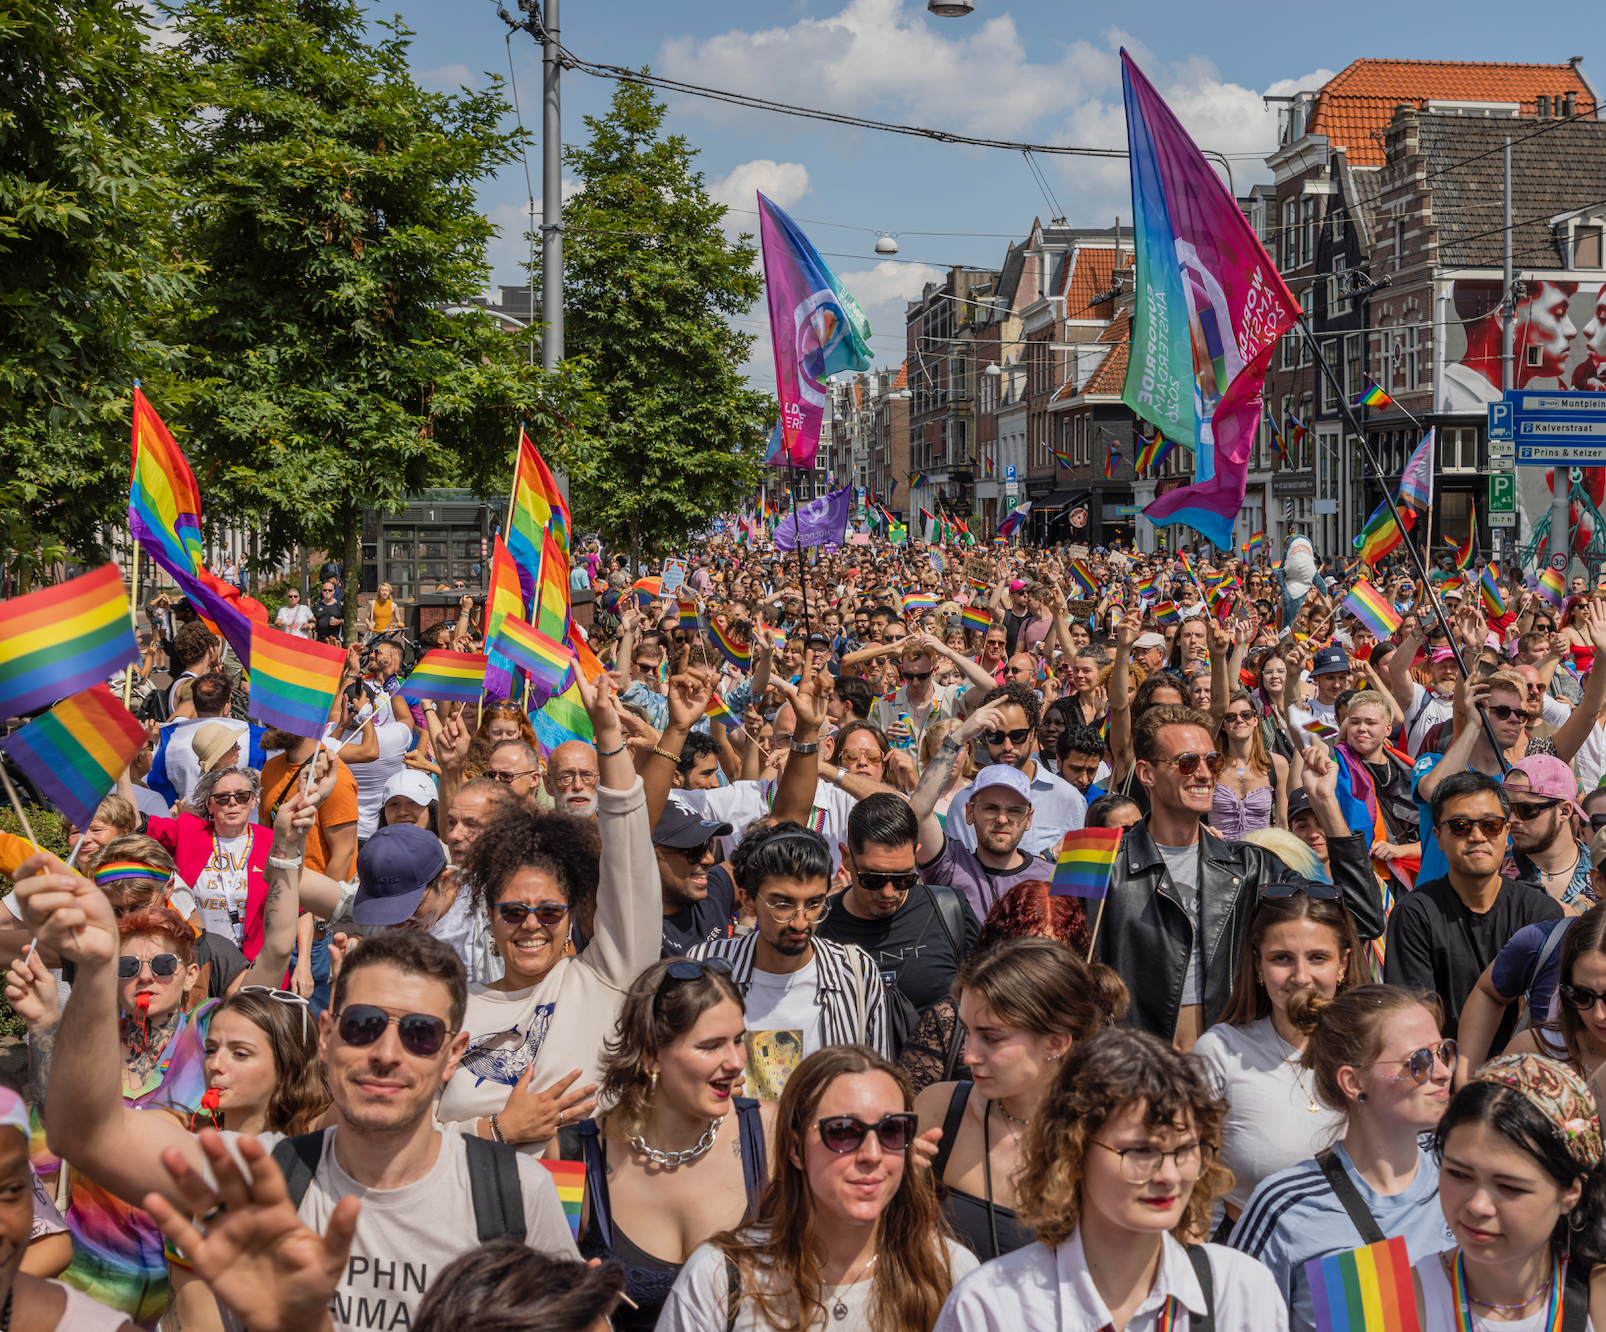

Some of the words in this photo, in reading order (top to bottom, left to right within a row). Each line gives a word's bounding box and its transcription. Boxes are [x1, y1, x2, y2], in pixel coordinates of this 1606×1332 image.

[1561, 400, 1606, 409] Muntplein
[1494, 405, 1507, 424] P
[1535, 424, 1593, 432] Kalverstraat
[1573, 449, 1602, 457] Keizer
[1495, 477, 1509, 496] P
[429, 510, 435, 520] 1
[1553, 558, 1565, 567] 30
[206, 879, 218, 890] IS
[347, 1255, 427, 1294] PHN
